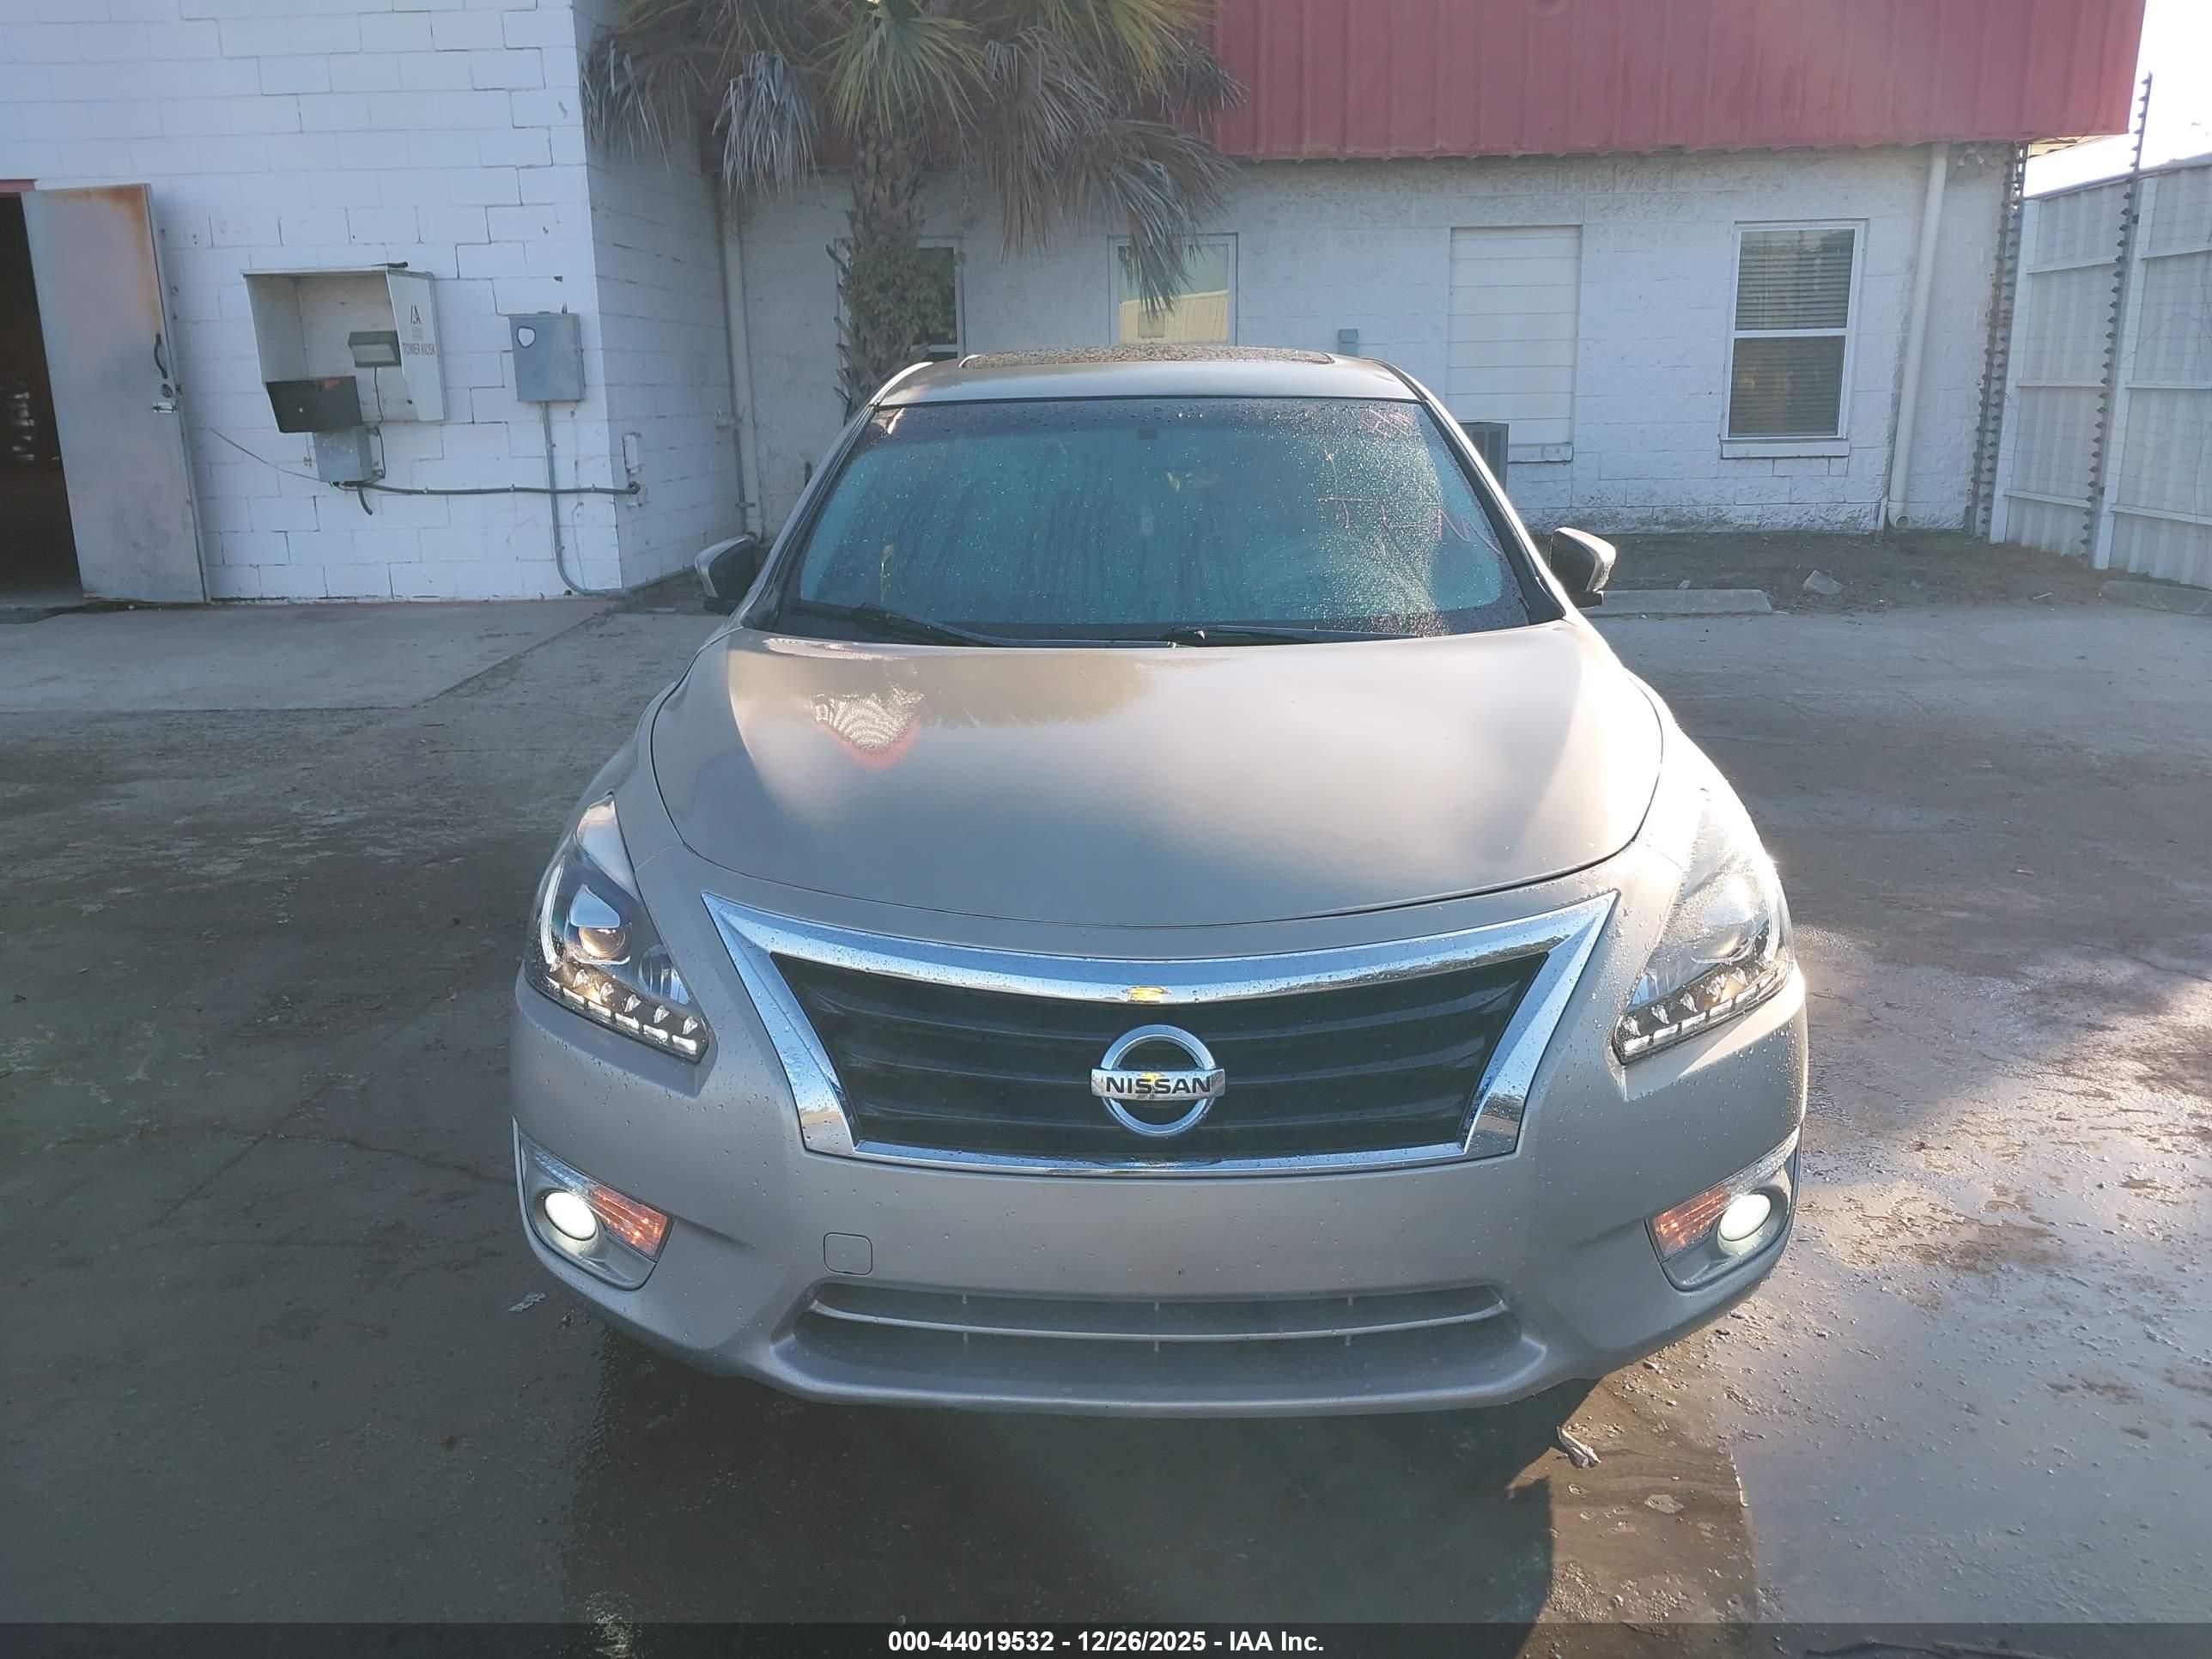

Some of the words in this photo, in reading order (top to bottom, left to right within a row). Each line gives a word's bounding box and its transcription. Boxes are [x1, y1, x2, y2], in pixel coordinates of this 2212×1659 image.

[403, 343, 420, 356] TOWER
[421, 343, 436, 356] KIOSK
[1106, 1077, 1211, 1094] NISSAN
